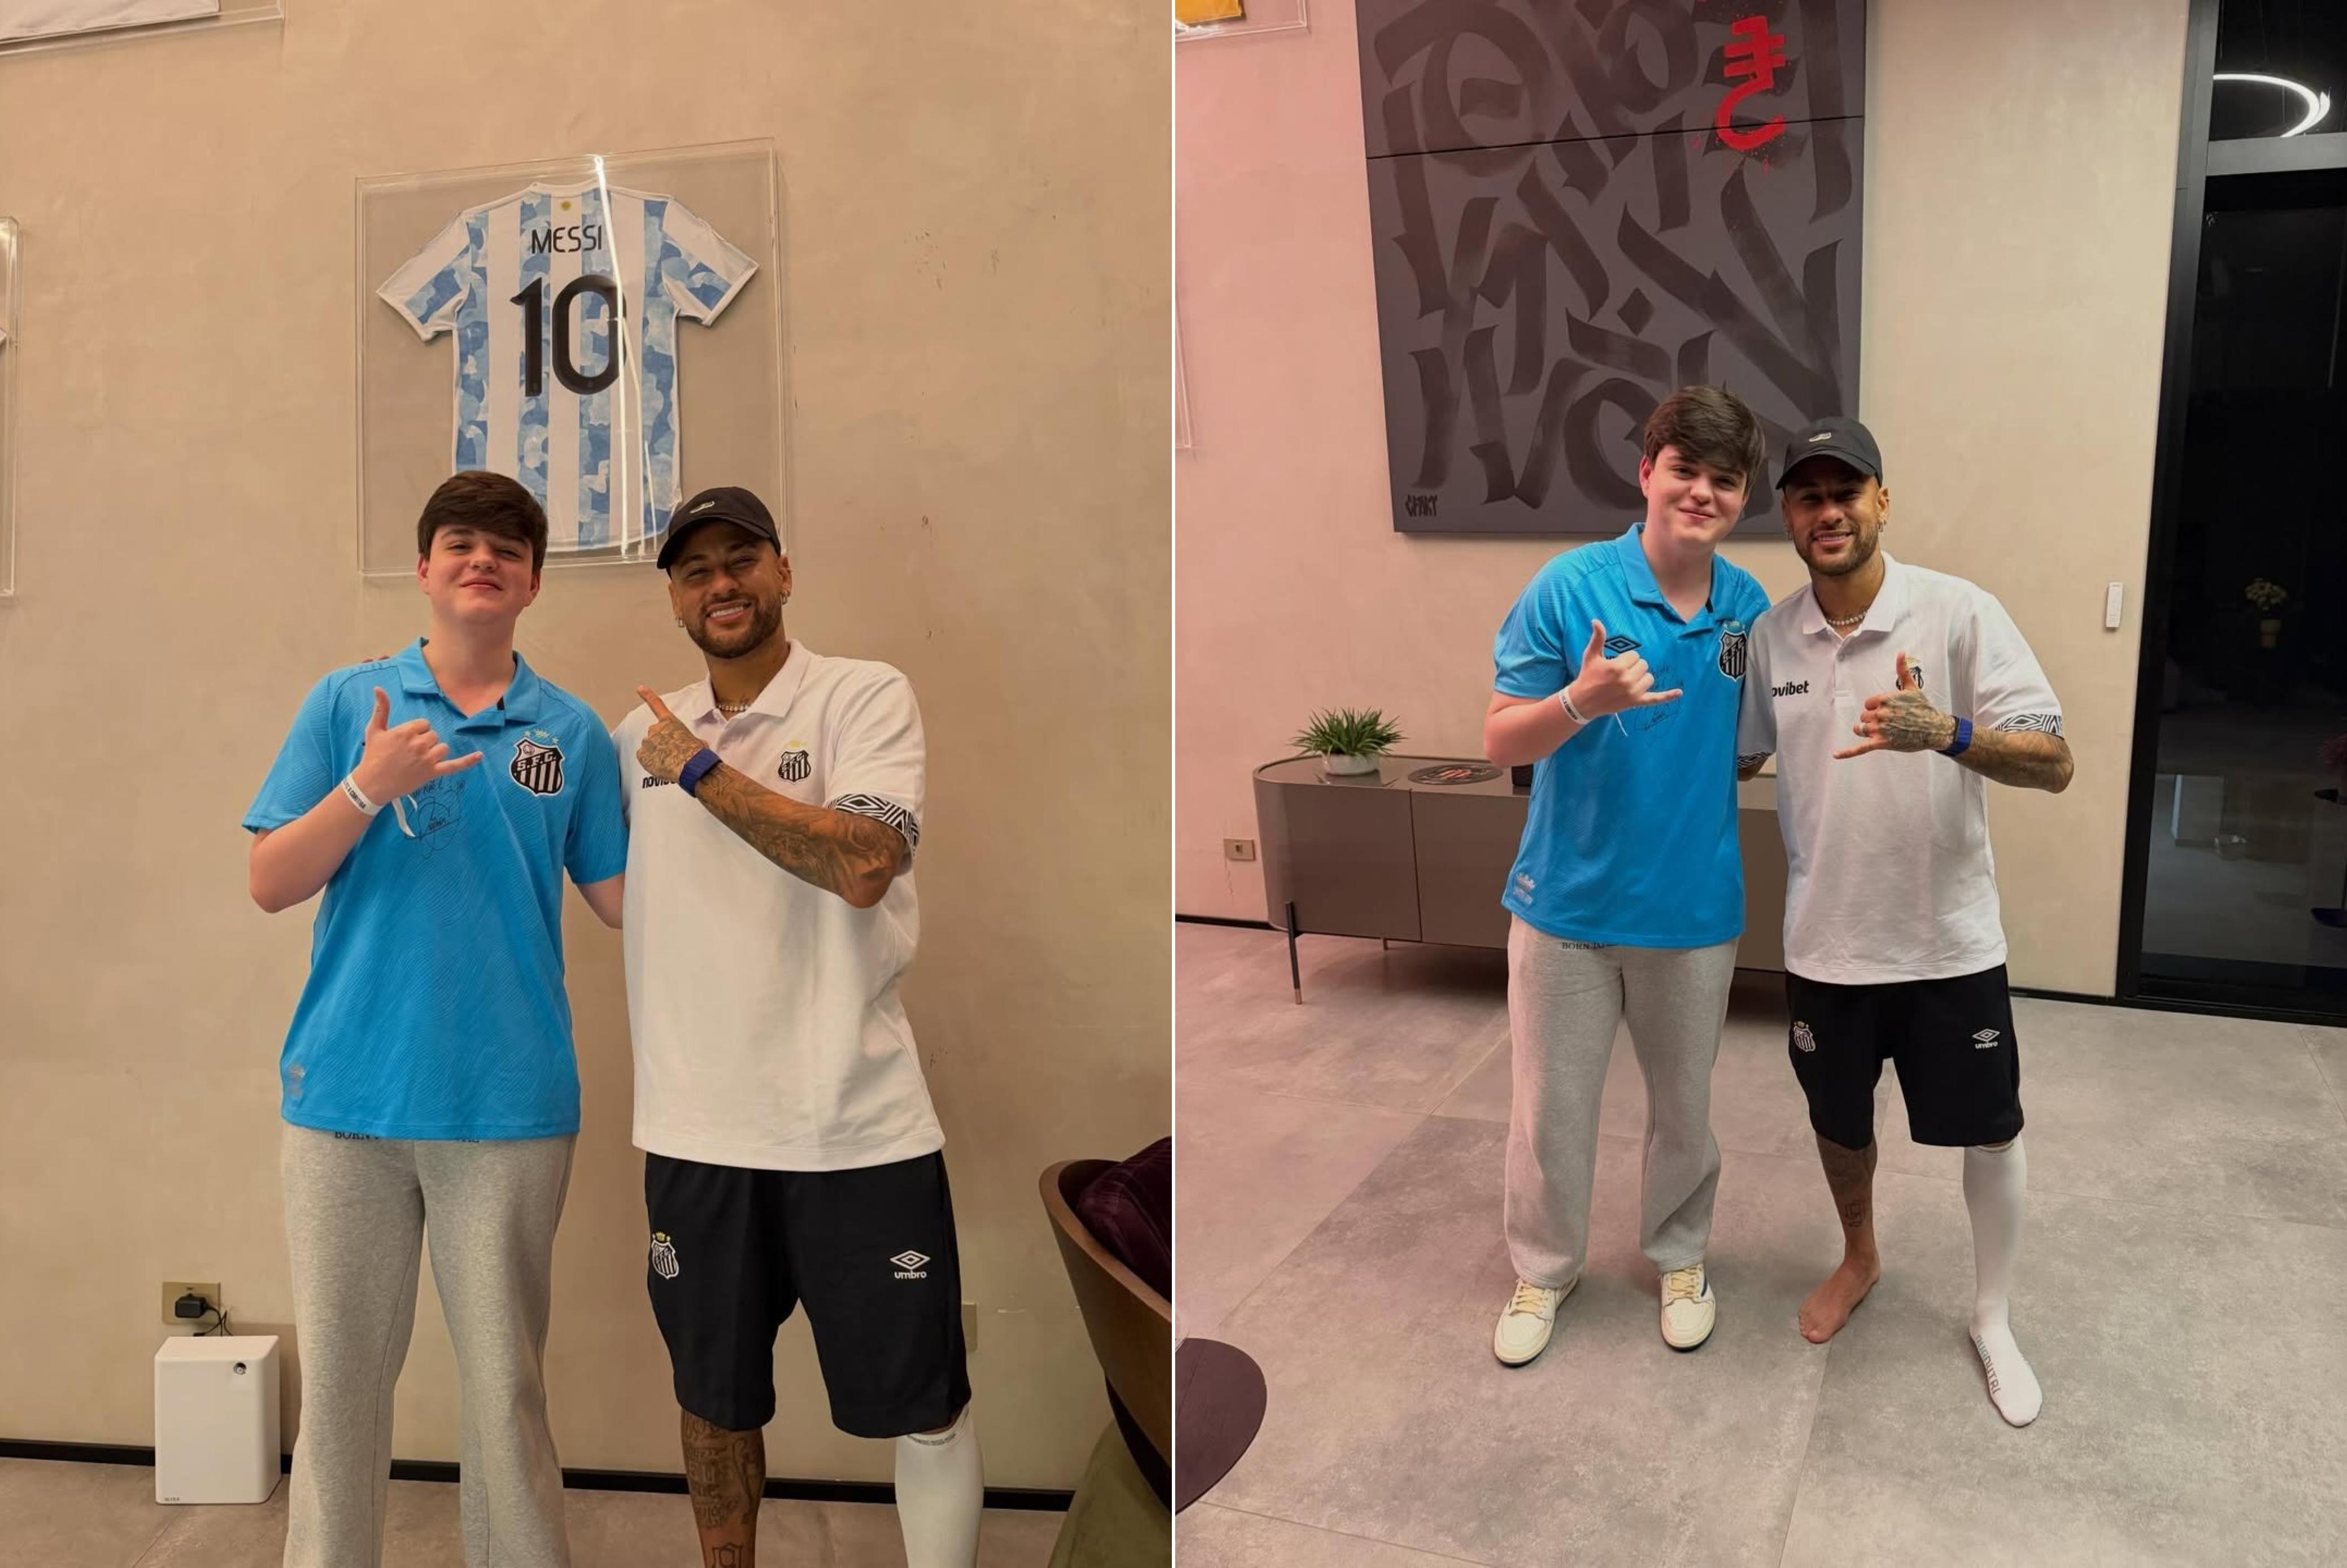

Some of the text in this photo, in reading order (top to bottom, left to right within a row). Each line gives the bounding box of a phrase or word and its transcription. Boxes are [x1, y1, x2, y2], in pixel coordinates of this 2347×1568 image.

[531, 224, 602, 254] MESSI
[509, 274, 627, 397] 10
[1772, 680, 1809, 697] ovibet
[894, 1269, 928, 1279] umbro
